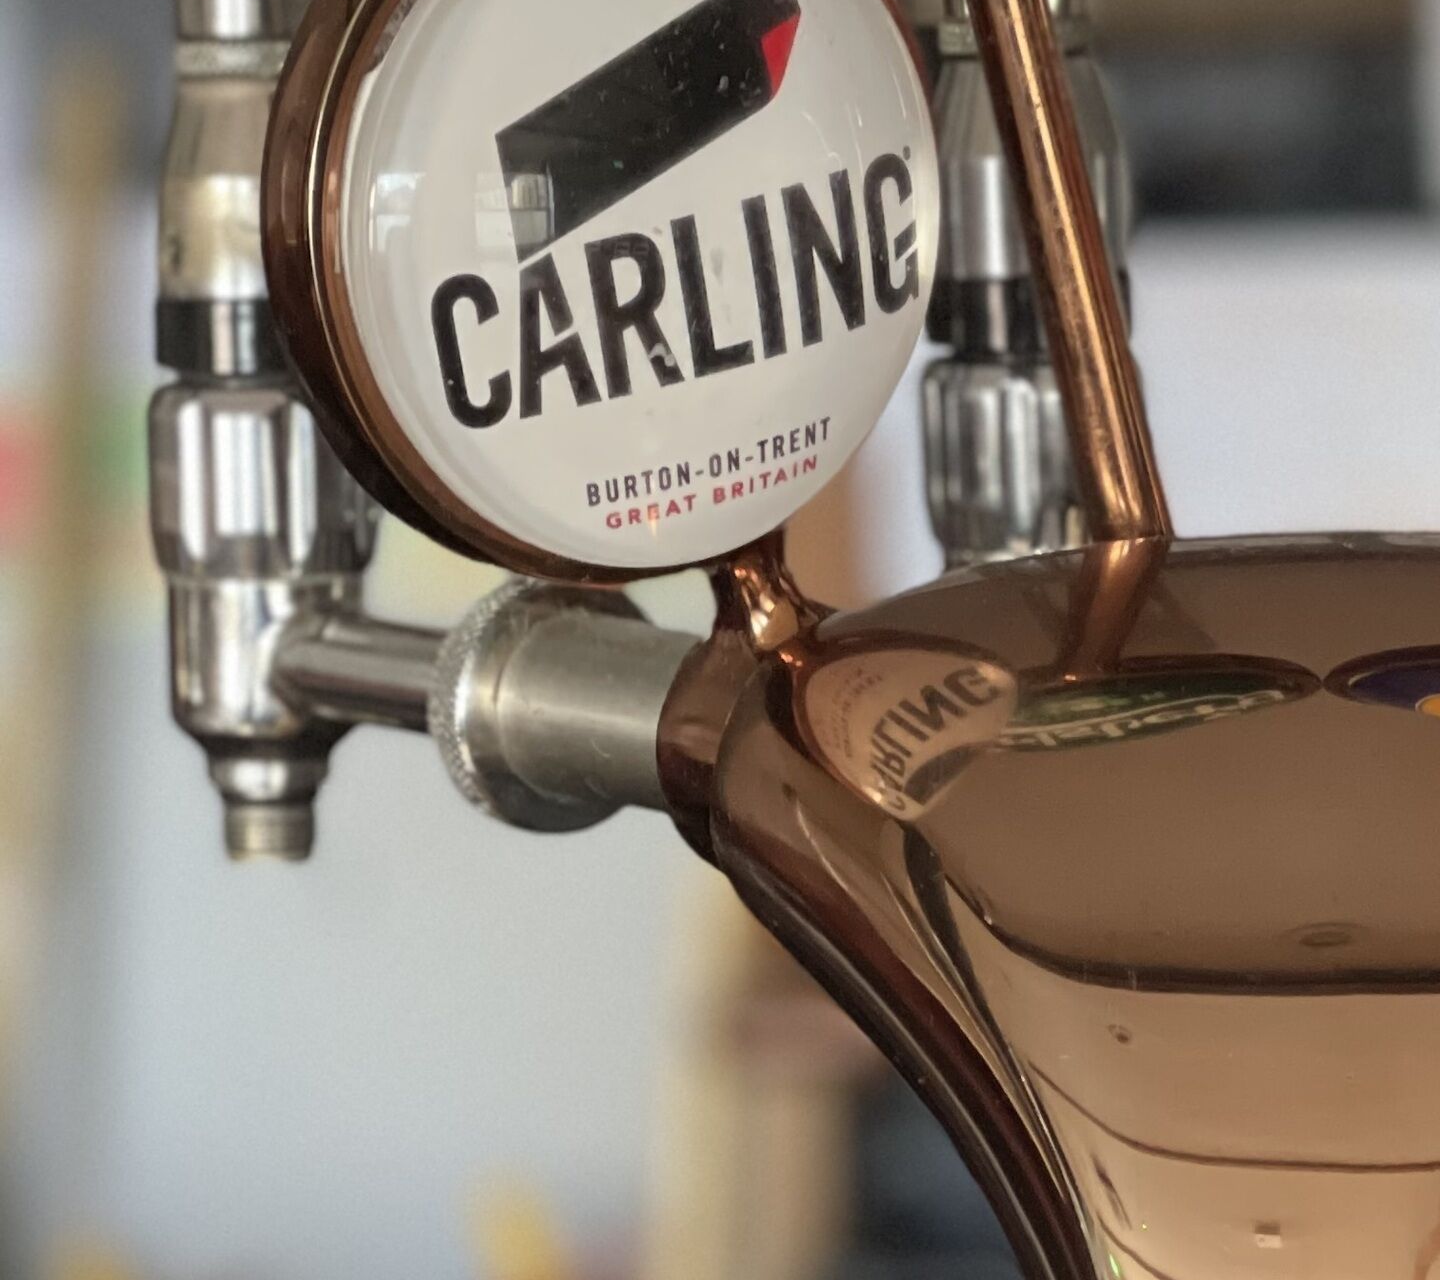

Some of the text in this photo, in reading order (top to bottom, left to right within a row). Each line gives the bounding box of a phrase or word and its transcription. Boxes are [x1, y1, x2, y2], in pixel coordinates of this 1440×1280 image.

[430, 152, 920, 430] CARLING
[586, 416, 831, 507] BURTON-ON-TRENT
[605, 454, 818, 530] GREAT BRITAIN
